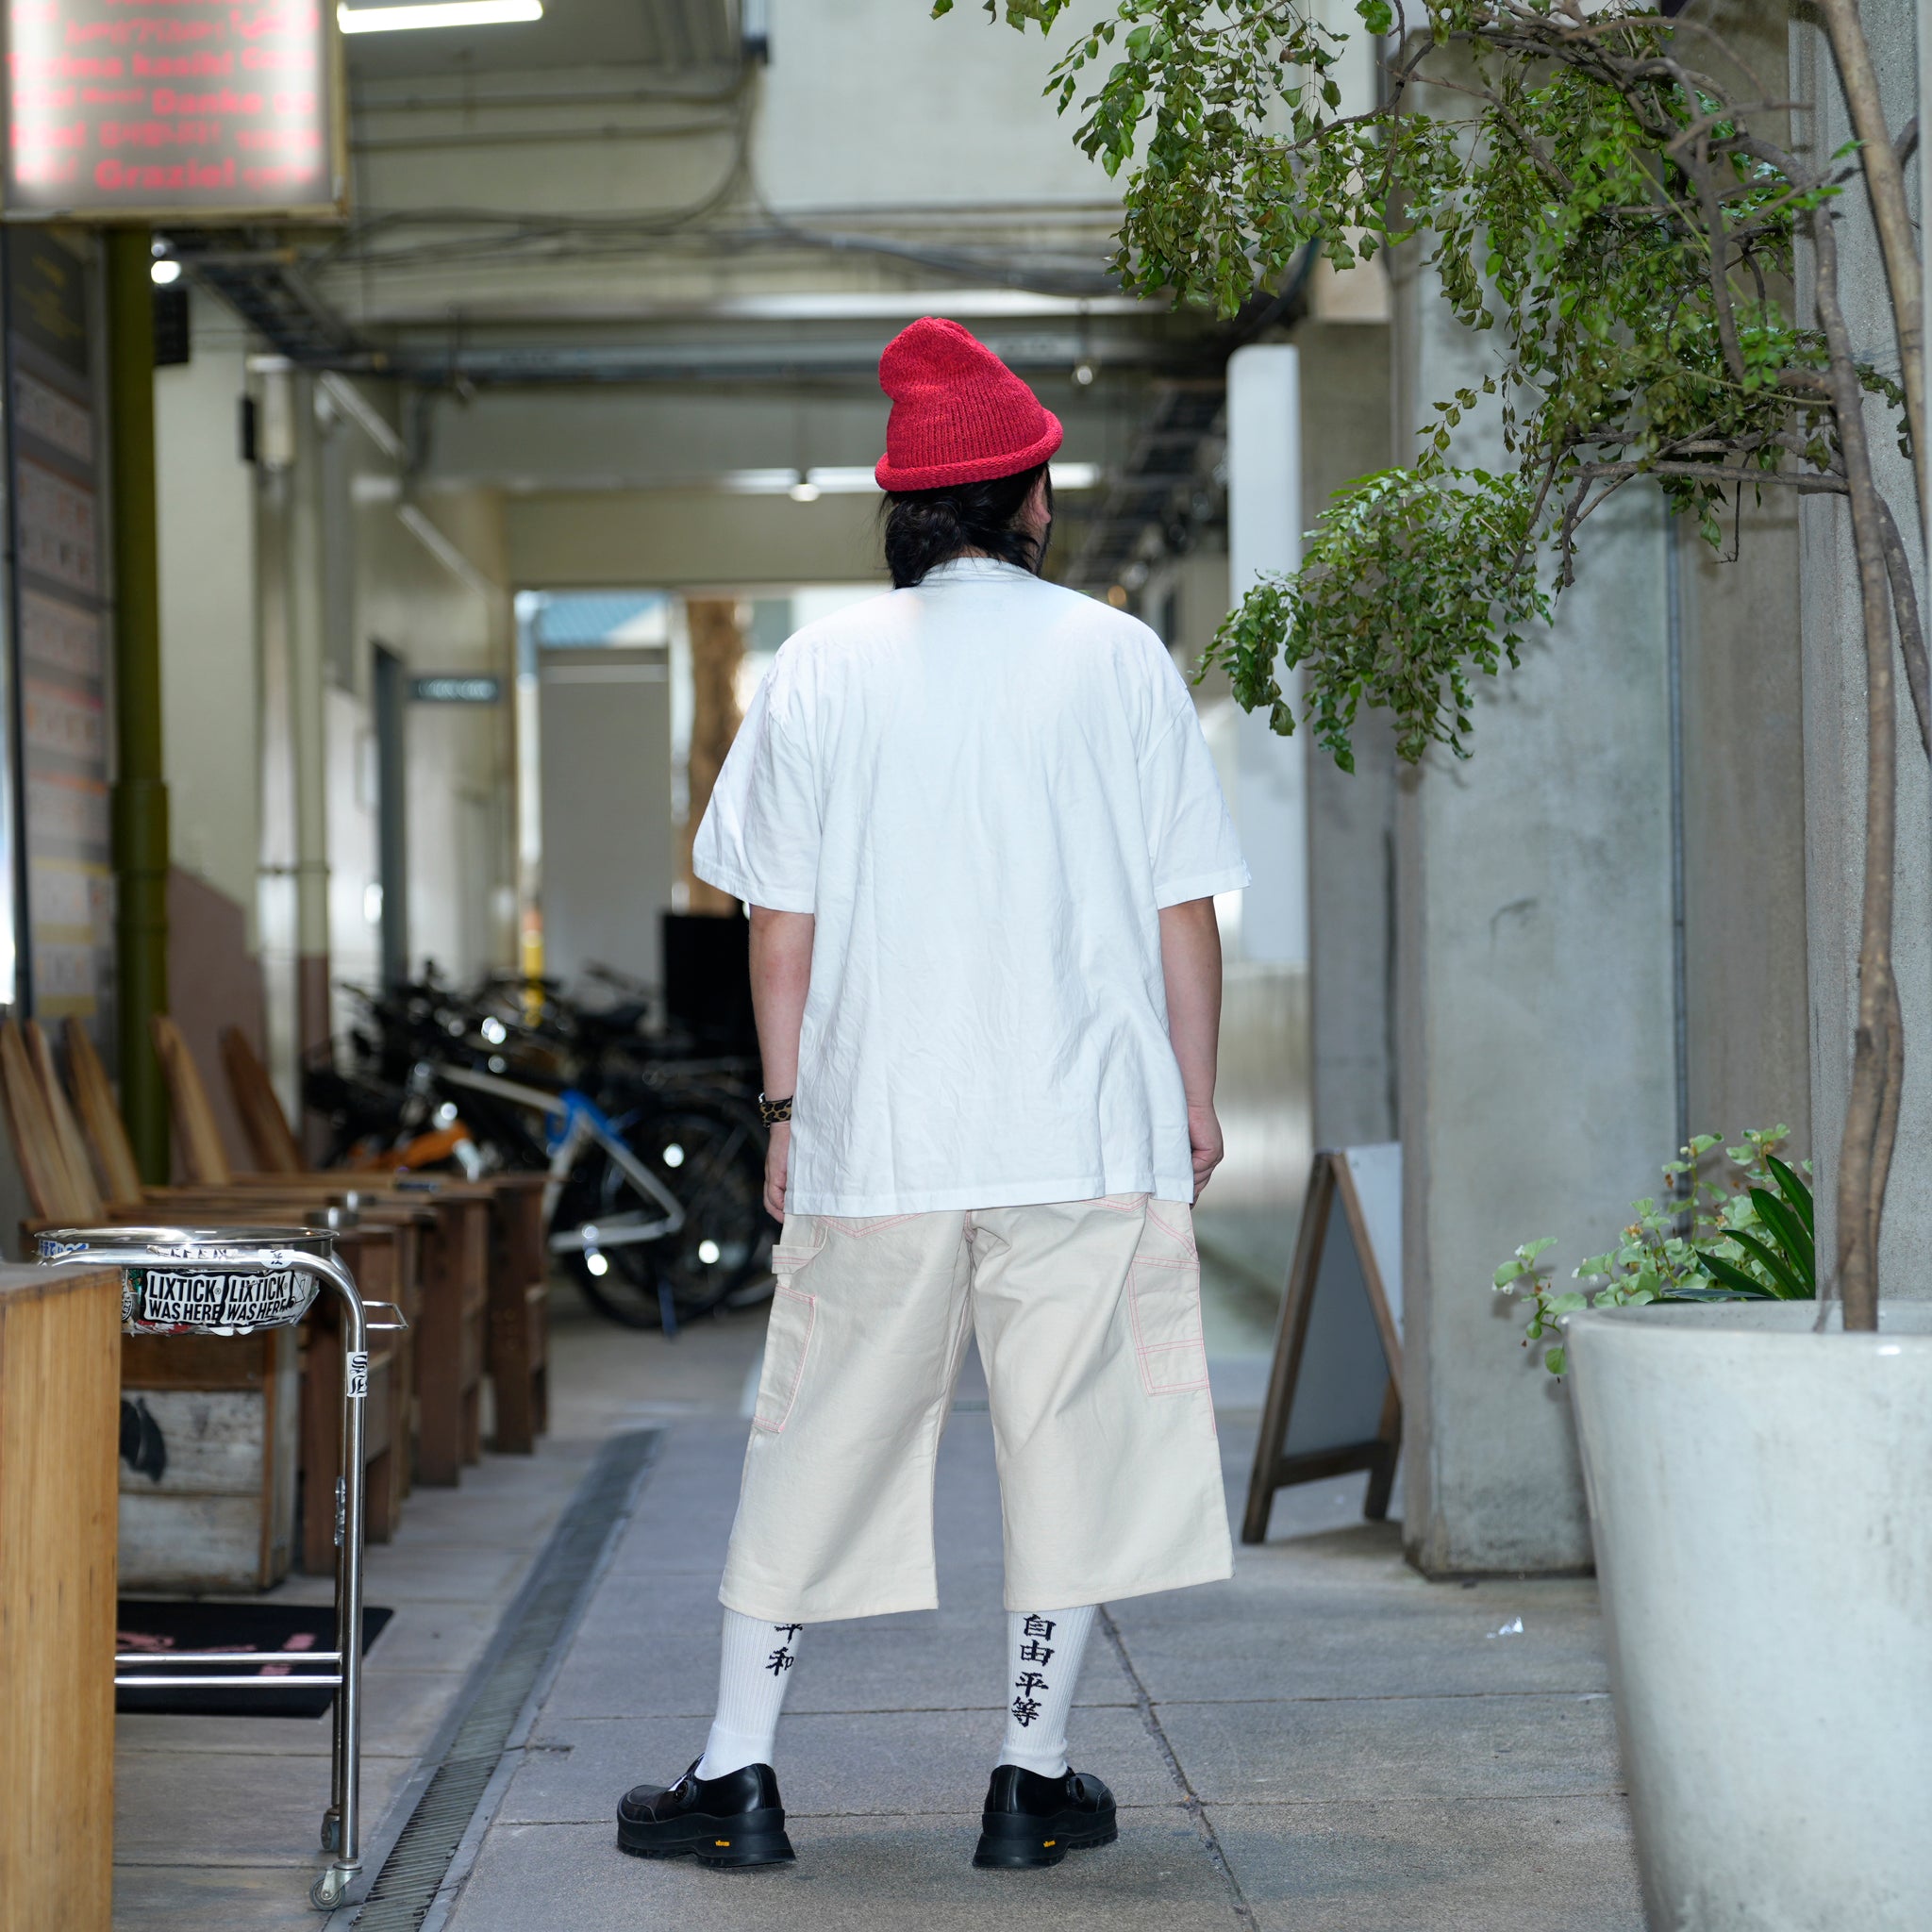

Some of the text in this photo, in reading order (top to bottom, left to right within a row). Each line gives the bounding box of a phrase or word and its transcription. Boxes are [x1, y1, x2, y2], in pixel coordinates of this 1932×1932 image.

[149, 1299, 181, 1321] WAS
[183, 1303, 222, 1321] HERE
[226, 1303, 257, 1321] WAS
[1010, 1613, 1057, 1728] 自由平等
